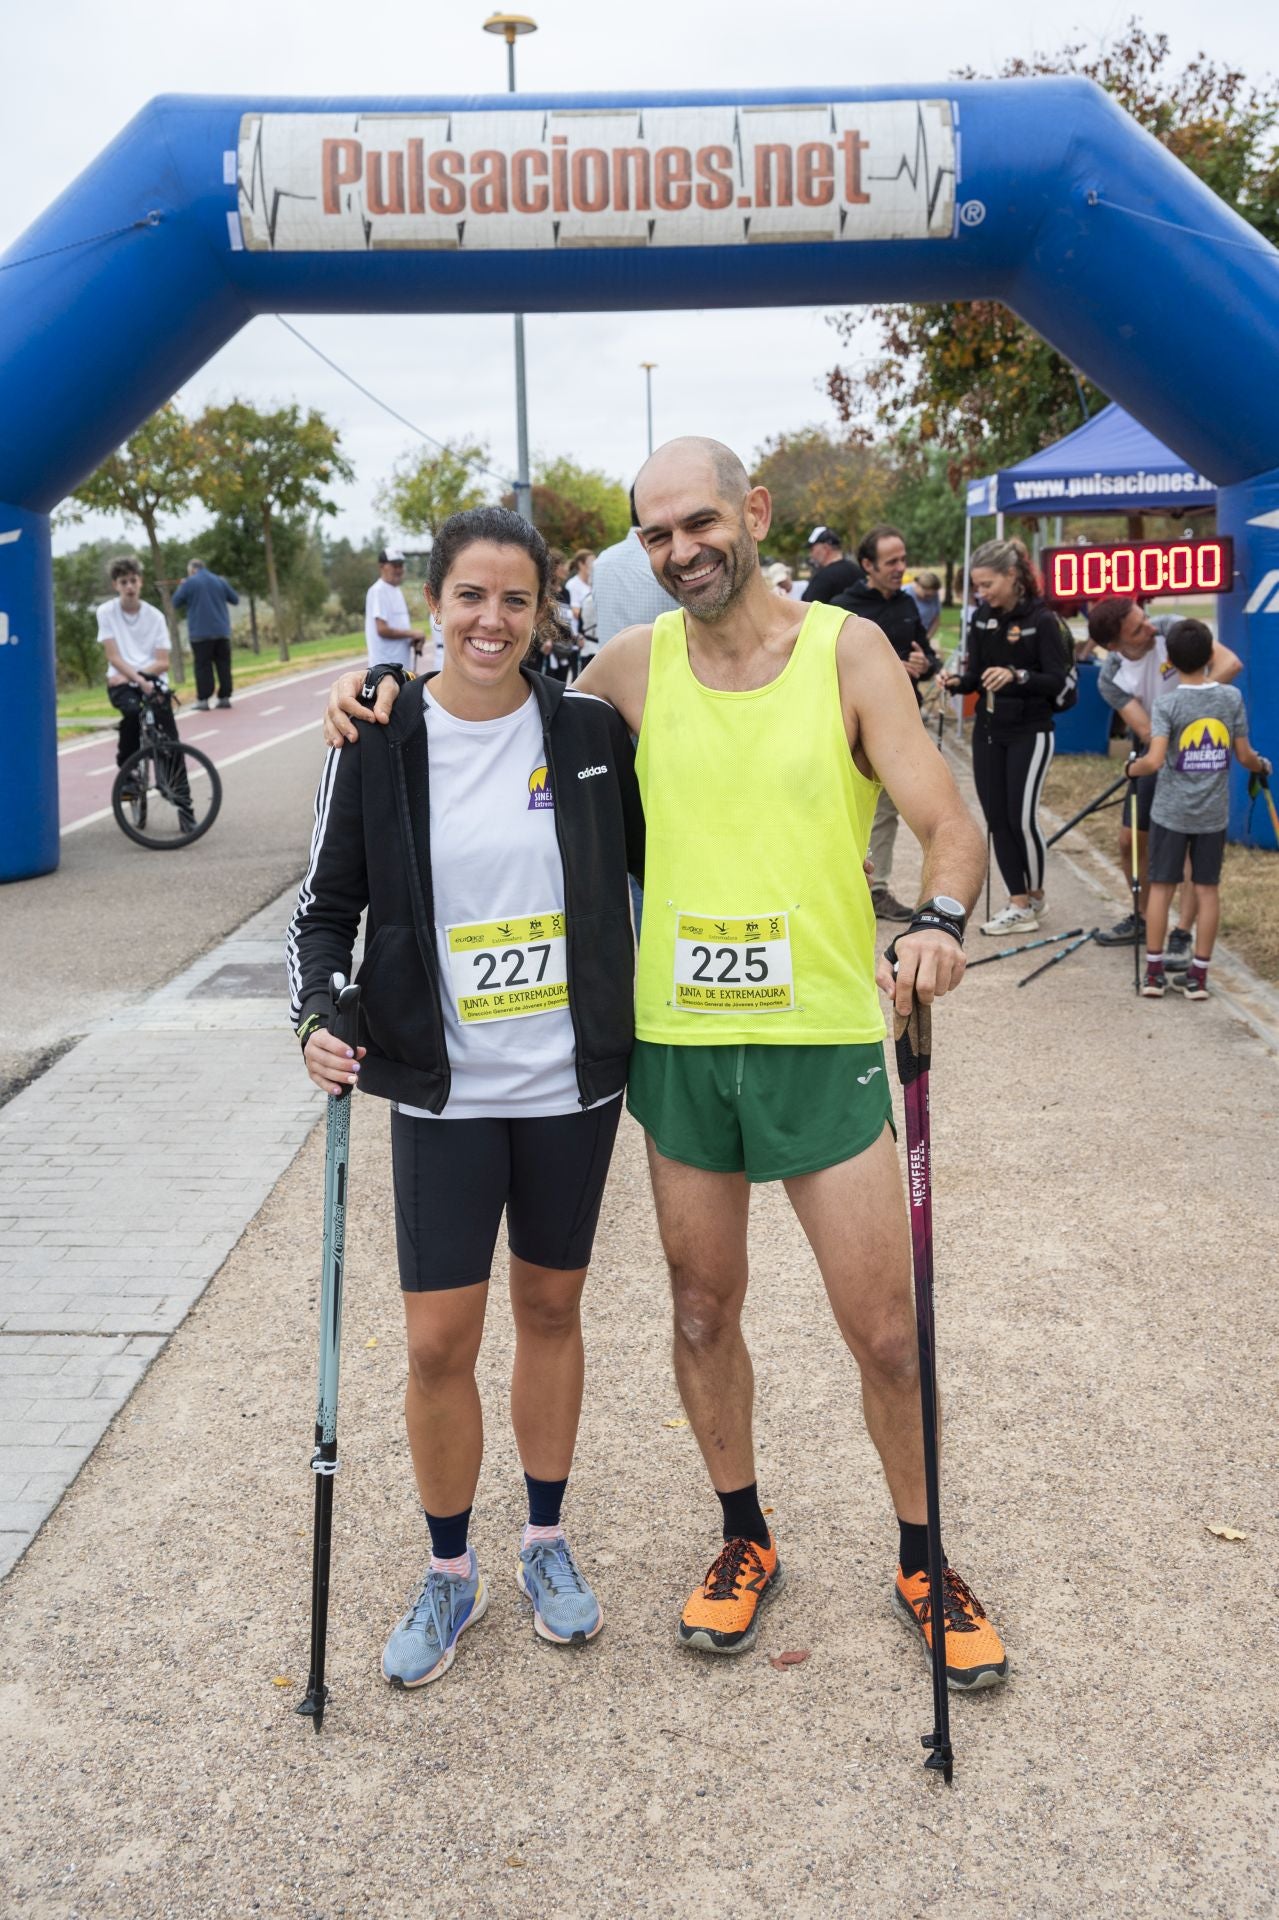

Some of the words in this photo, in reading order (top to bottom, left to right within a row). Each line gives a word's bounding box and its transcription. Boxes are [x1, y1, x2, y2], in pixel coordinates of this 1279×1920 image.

[320, 130, 870, 216] Pulsaciones.net
[1014, 471, 1218, 500] www.pulsaciones.n
[1055, 545, 1221, 596] 00:00:00
[472, 943, 551, 991] 227
[692, 945, 769, 983] 225
[463, 998, 490, 1010] JUNTA
[493, 995, 505, 1006] DE
[509, 985, 569, 1004] EXTREMADURA
[493, 1006, 515, 1015] General
[680, 986, 702, 998] JUNTA
[705, 989, 716, 998] DE
[720, 988, 786, 999] EXTREMADURA
[910, 1145, 923, 1207] NEWFEEL
[333, 1201, 345, 1249] newfeel
